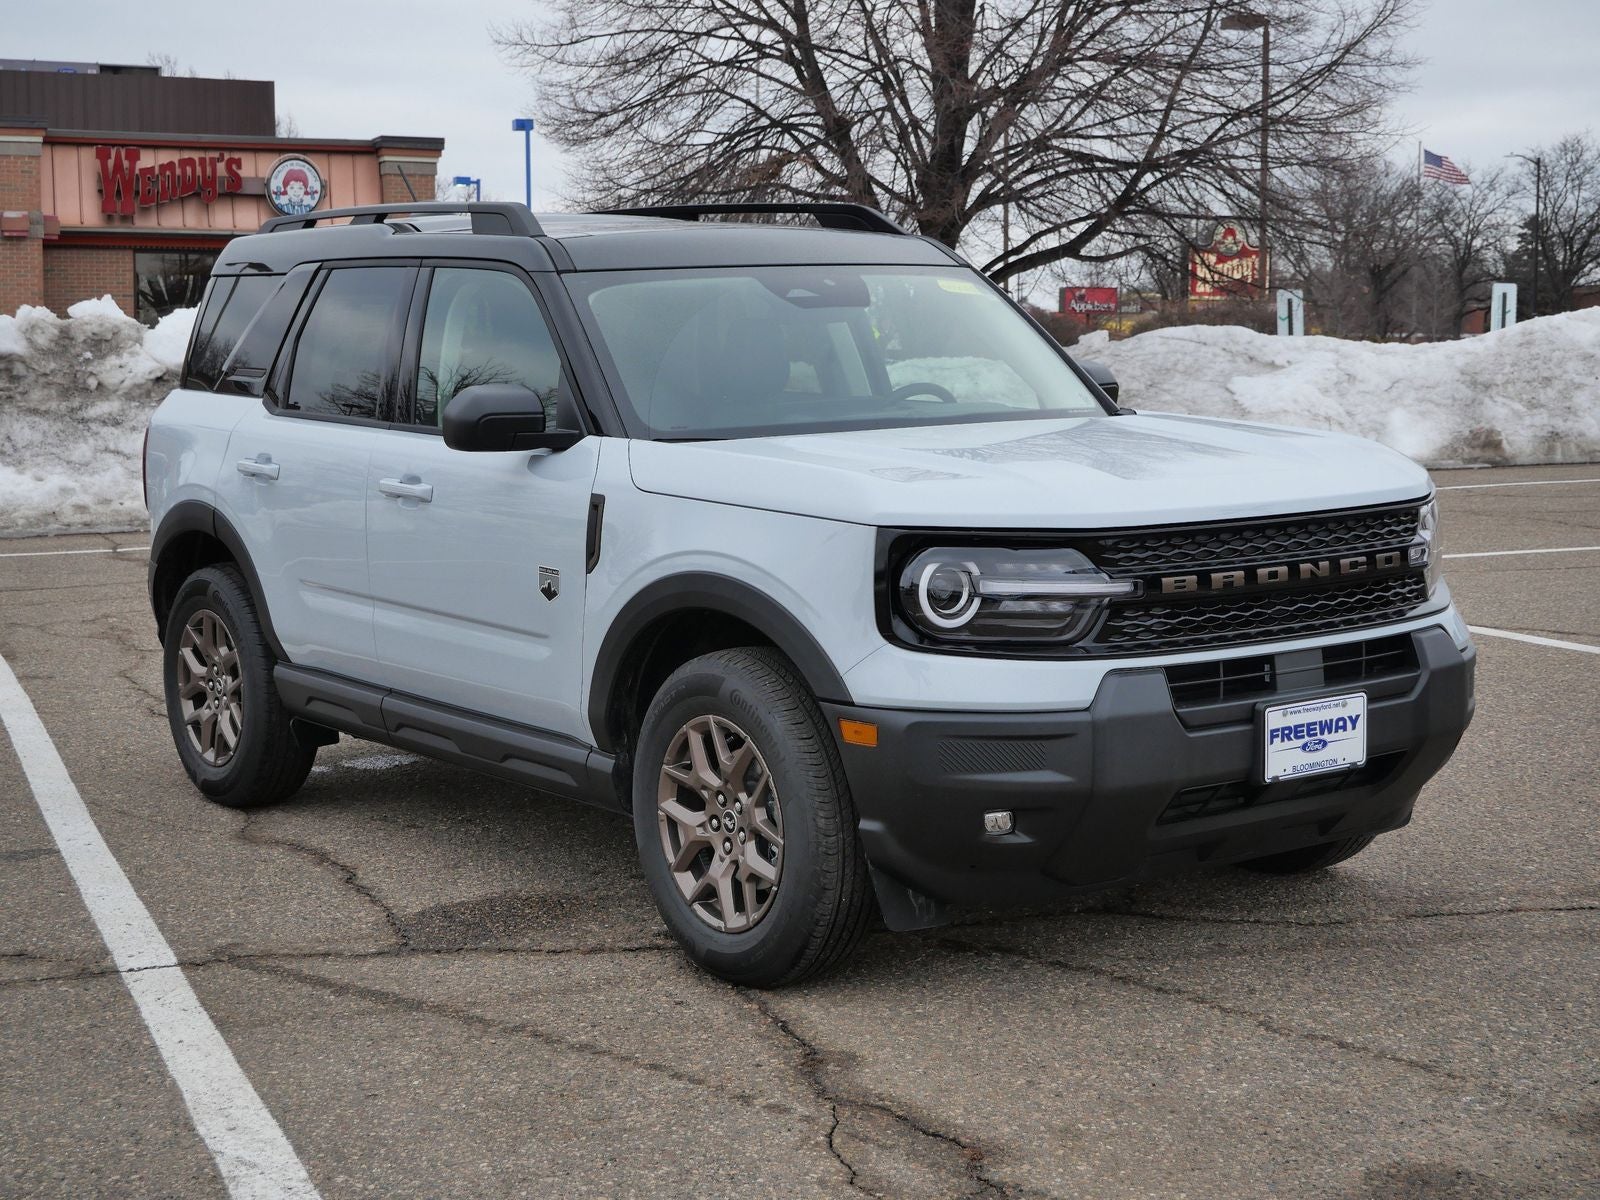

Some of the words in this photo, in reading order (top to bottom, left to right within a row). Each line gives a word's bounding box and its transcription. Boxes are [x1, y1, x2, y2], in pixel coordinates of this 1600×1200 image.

[1161, 551, 1400, 593] BRONCO
[1289, 702, 1341, 715] www.freewayford.net
[1269, 714, 1361, 746] FREEWAY
[1304, 740, 1325, 752] Ford
[1292, 758, 1338, 772] BLOOMINGTON
